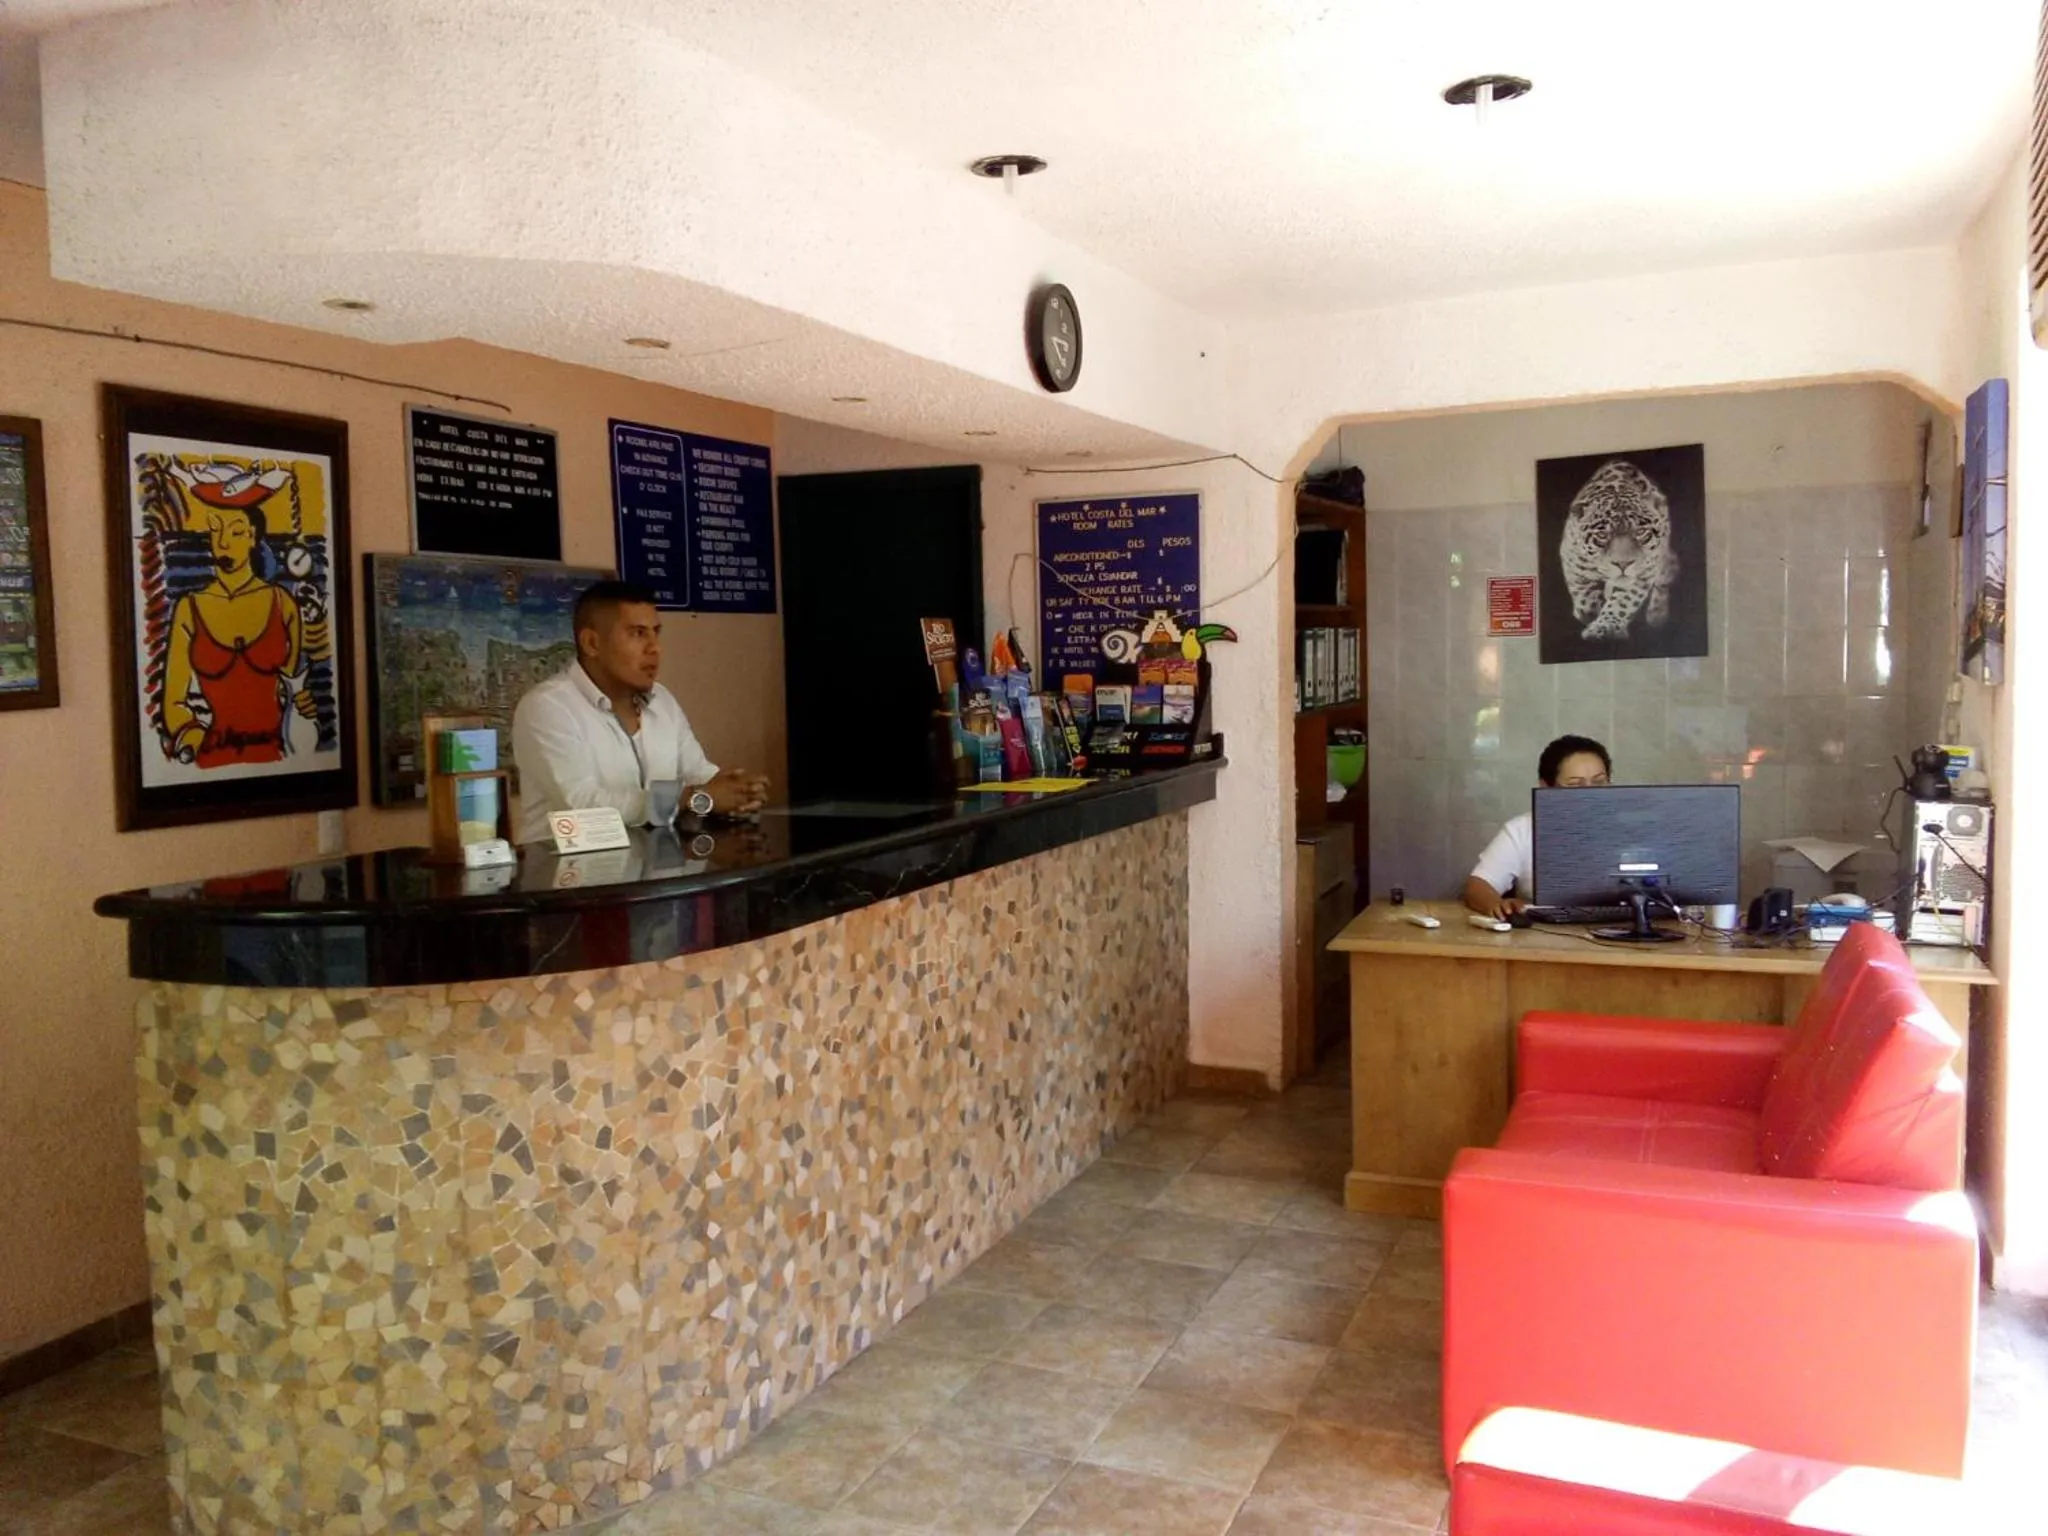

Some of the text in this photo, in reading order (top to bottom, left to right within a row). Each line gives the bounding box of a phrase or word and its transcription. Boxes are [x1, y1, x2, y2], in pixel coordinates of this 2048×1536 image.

[439, 424, 459, 436] HOTEL
[494, 433, 508, 444] DEL
[1058, 506, 1157, 522] HOTEL COSTA DEL MAR
[1072, 520, 1134, 530] ROOM RATES
[1162, 537, 1192, 547] PESOS
[1120, 585, 1142, 594] RATE
